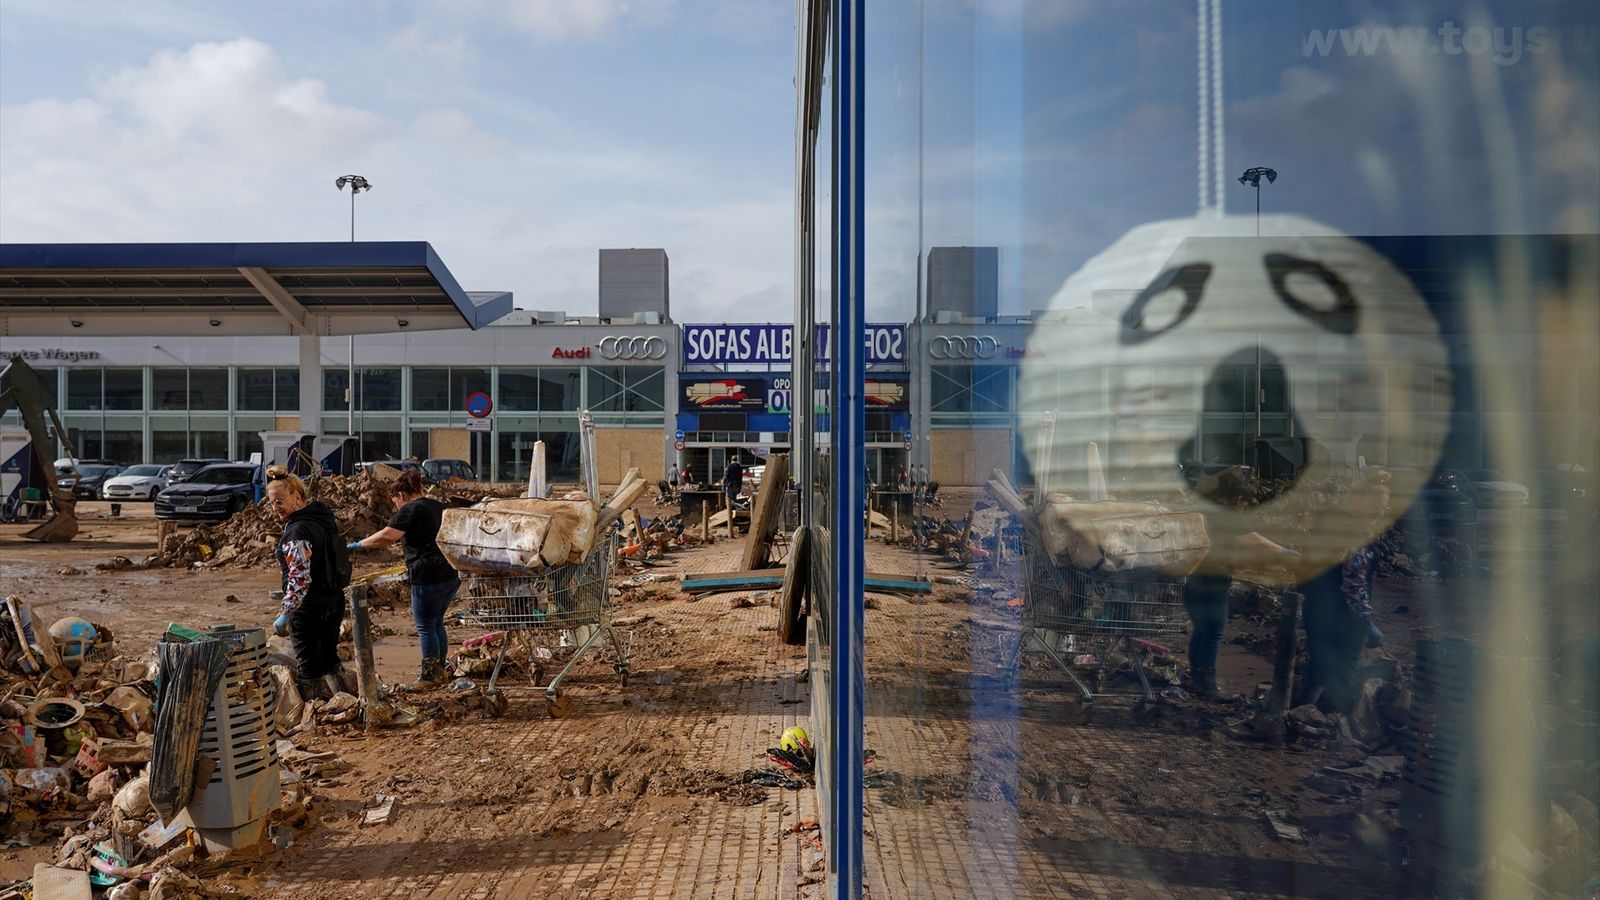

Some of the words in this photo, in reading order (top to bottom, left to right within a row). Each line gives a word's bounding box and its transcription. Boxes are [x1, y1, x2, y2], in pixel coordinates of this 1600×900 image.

[687, 328, 751, 360] SOFAS
[755, 328, 792, 360] ALB
[41, 348, 99, 362] Wagen
[551, 346, 591, 359] Audi
[773, 379, 790, 389] OPO
